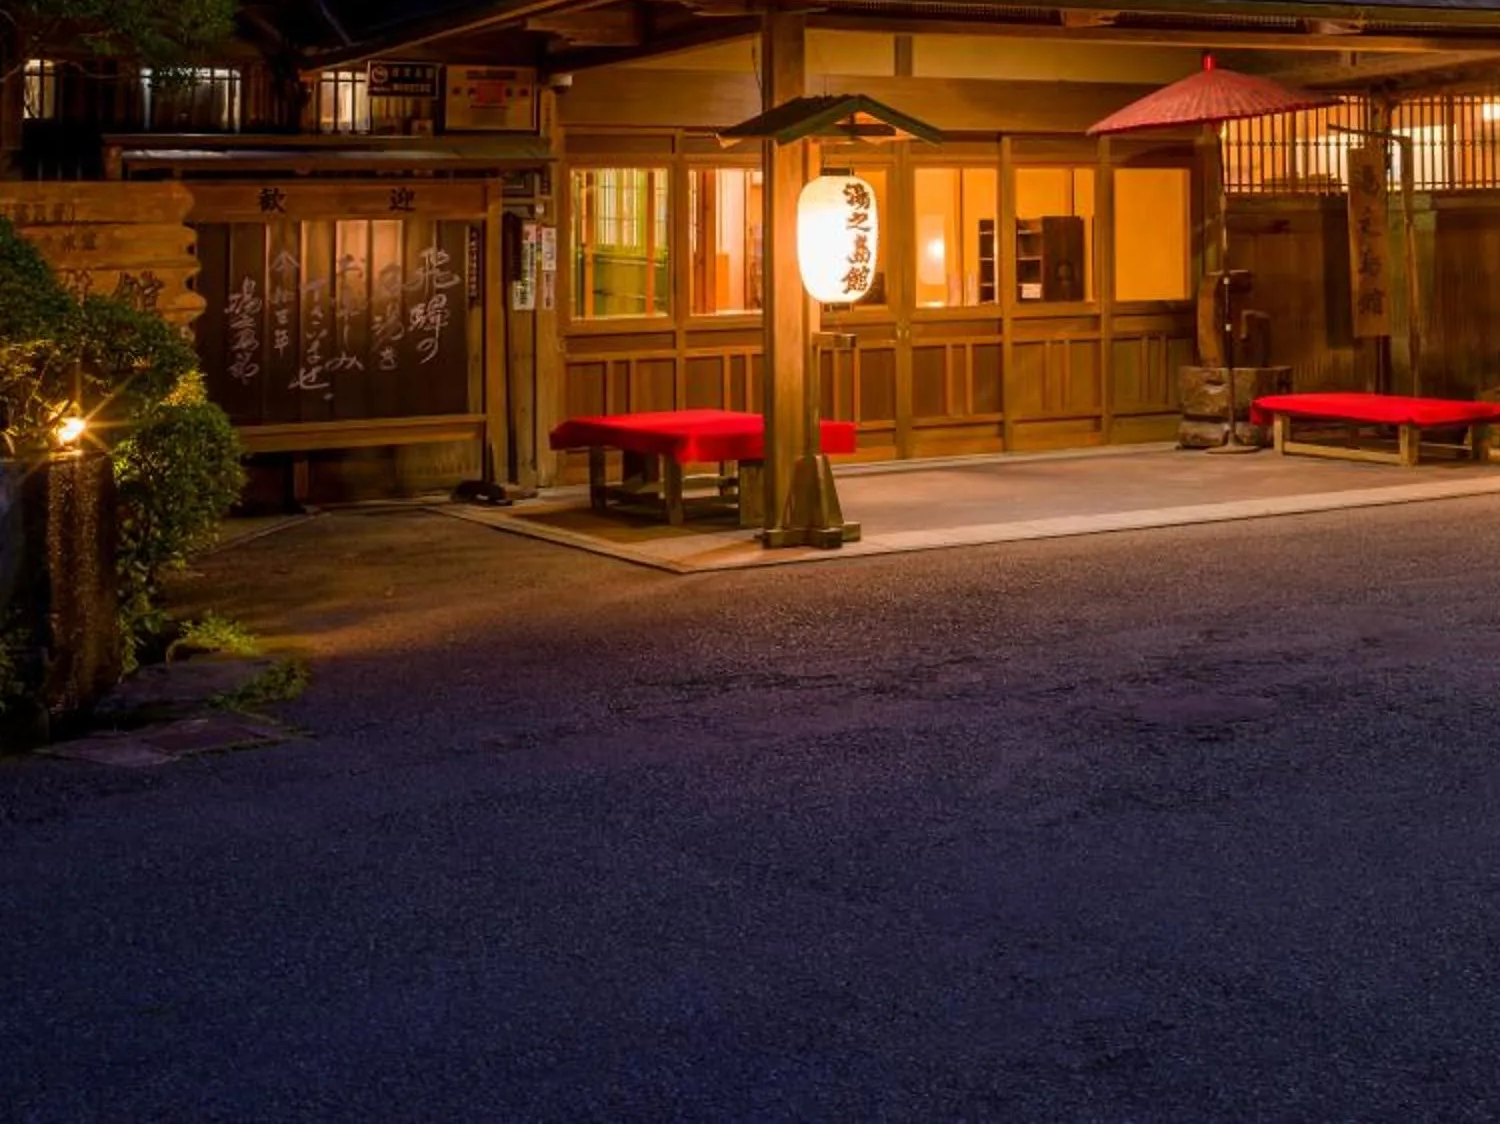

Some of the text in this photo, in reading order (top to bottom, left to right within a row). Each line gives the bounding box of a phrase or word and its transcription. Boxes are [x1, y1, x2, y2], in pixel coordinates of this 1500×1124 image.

[259, 188, 417, 213] 歓迎
[841, 182, 872, 294] 湯之島館
